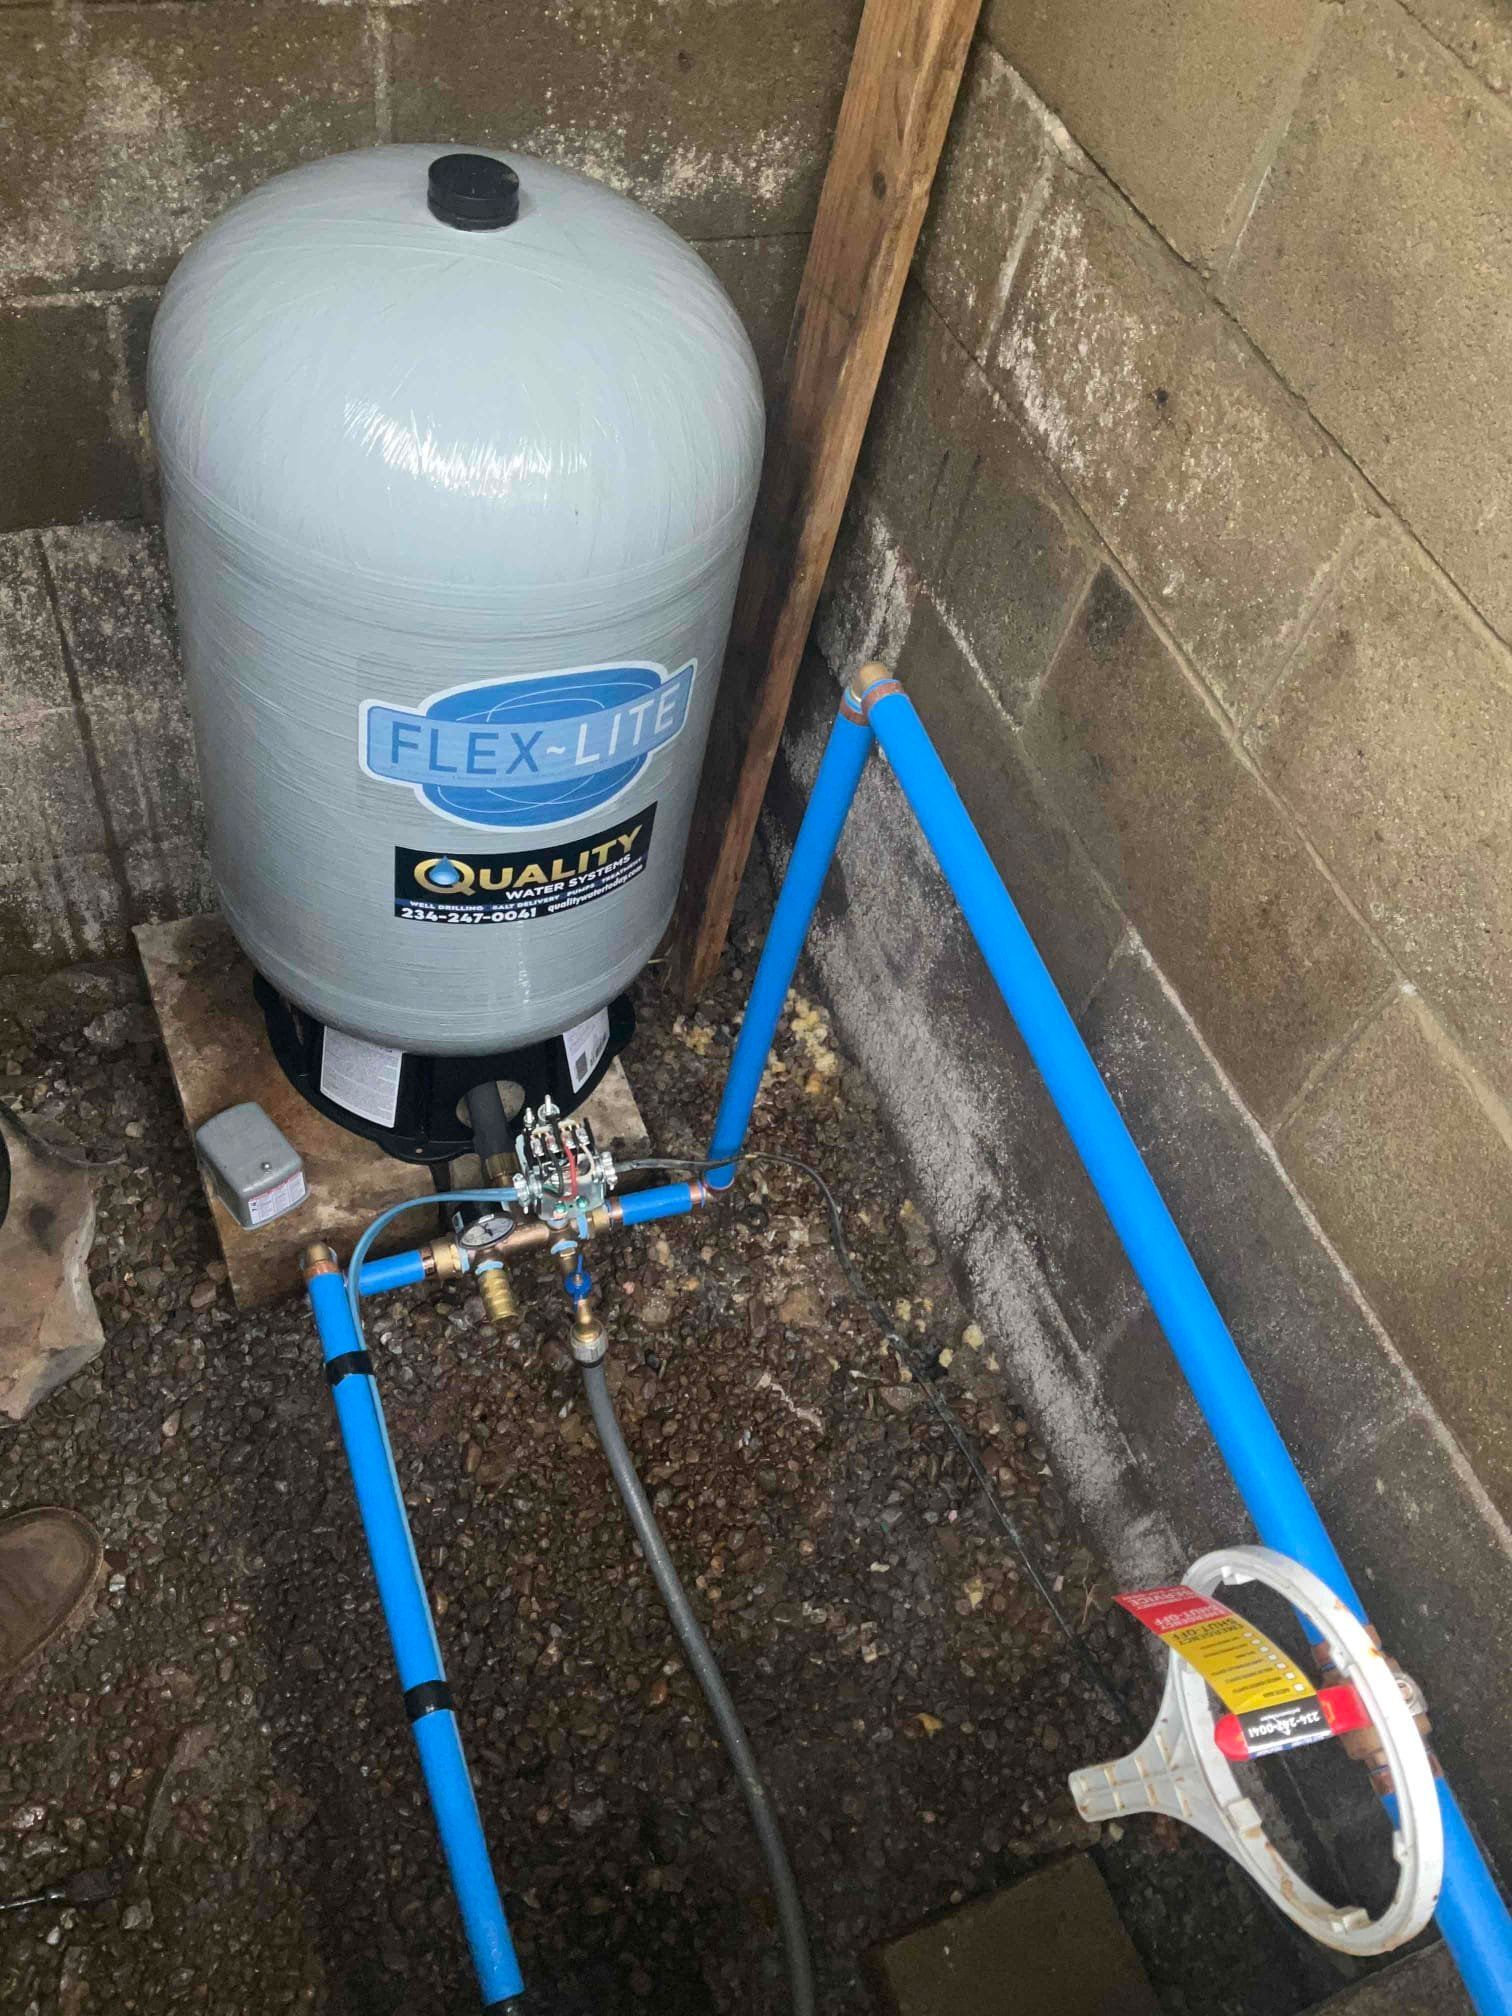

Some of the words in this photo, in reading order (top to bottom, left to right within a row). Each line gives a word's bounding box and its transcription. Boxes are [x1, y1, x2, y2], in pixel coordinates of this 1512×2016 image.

[409, 900, 436, 910] WELL
[438, 904, 484, 912] DRILLING
[492, 903, 515, 911] SALT
[517, 895, 560, 909] DELIVERY
[566, 883, 596, 898] PUMPS
[602, 856, 642, 884] TREATMENT
[413, 824, 643, 896] QUALITY
[505, 882, 564, 900] WATER
[568, 853, 631, 887] SYSTEMS
[400, 906, 537, 924] 234-247-0041
[547, 863, 643, 913] qualitywatertoday.com
